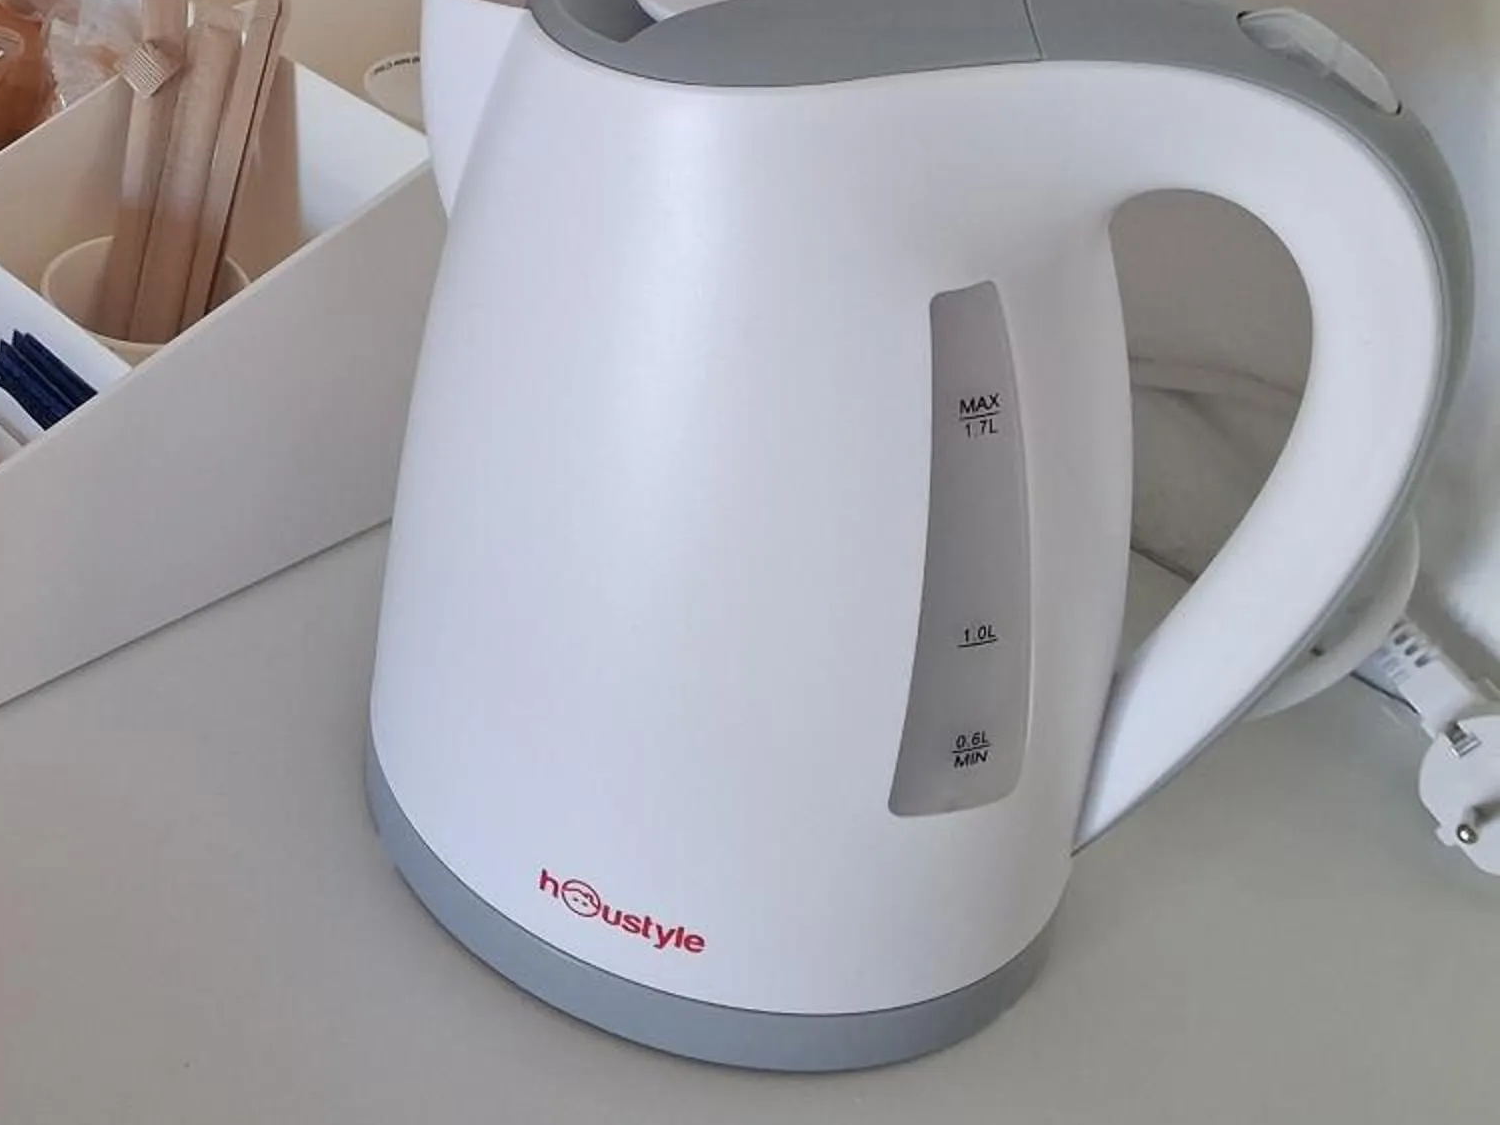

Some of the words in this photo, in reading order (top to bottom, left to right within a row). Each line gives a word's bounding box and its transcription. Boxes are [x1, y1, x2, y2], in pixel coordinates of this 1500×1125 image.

[959, 393, 1001, 414] MAX
[965, 418, 998, 439] 1.7L
[963, 624, 997, 643] 1.0L
[955, 731, 989, 749] 0.6L
[954, 750, 989, 768] MIN
